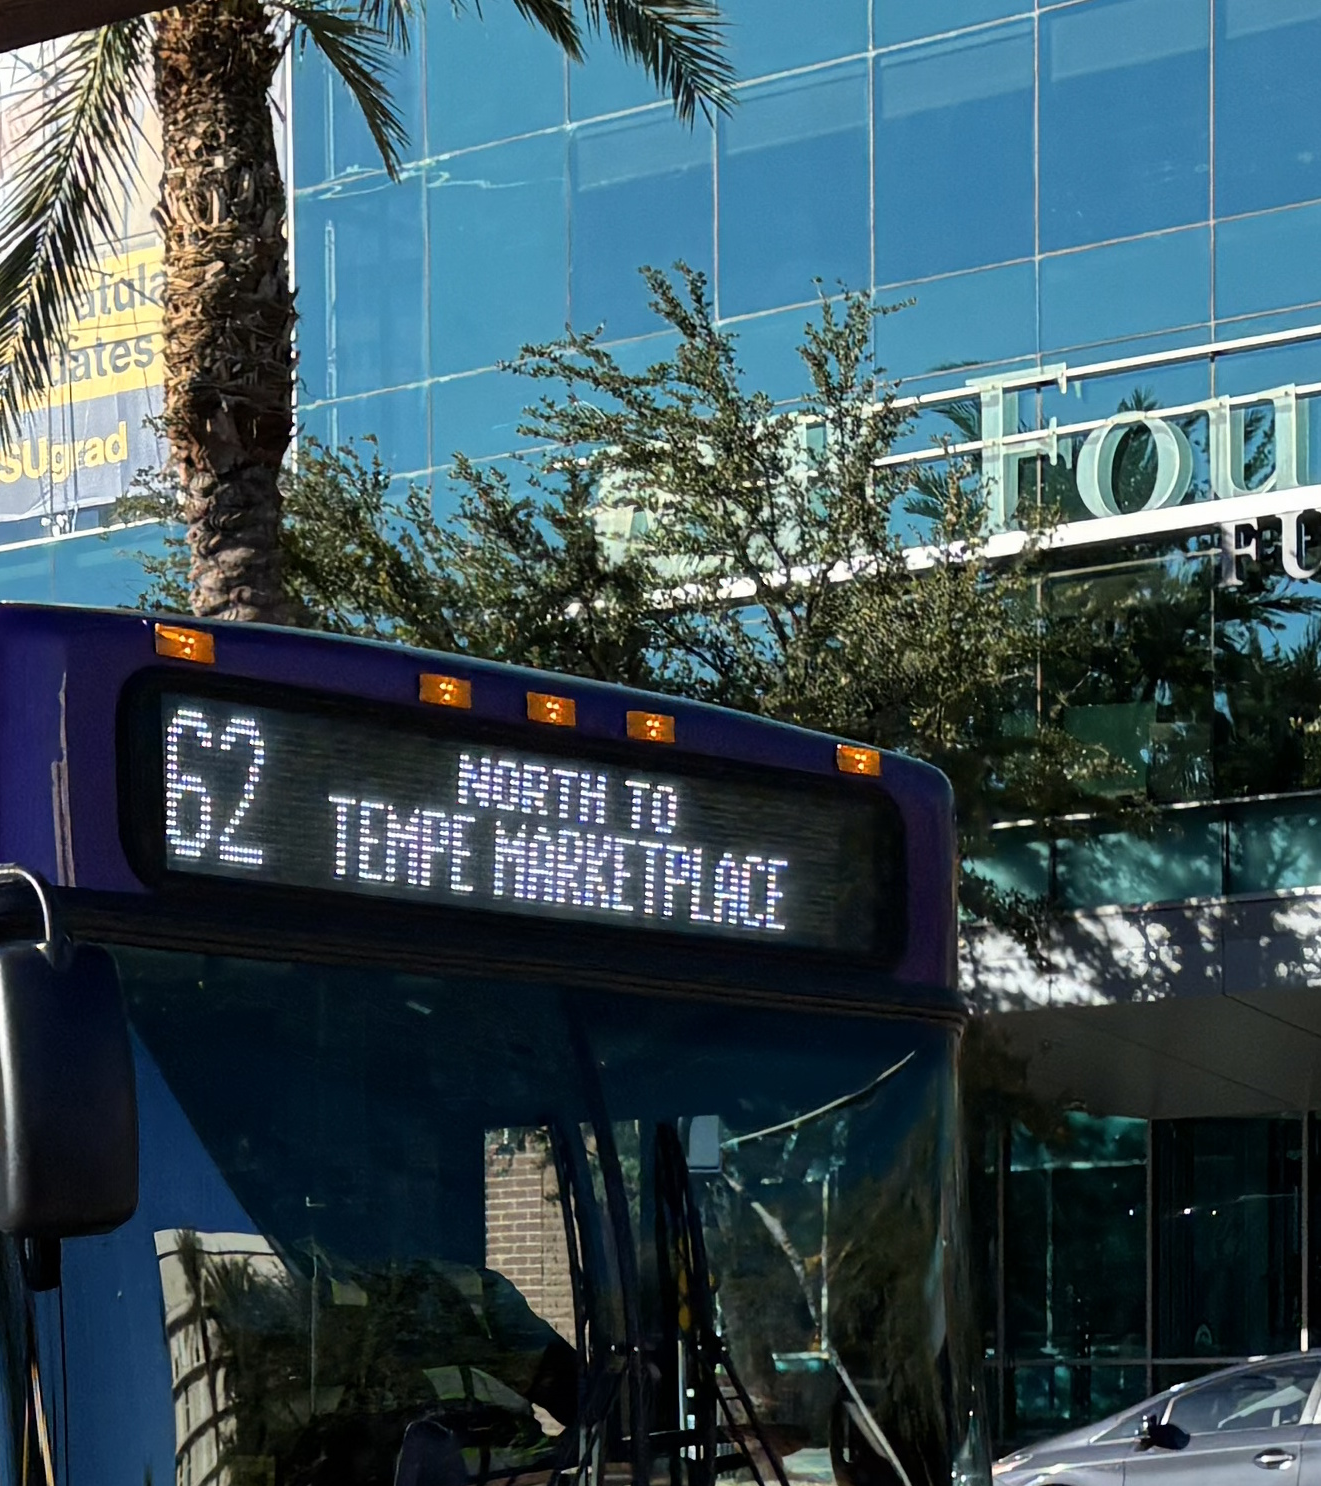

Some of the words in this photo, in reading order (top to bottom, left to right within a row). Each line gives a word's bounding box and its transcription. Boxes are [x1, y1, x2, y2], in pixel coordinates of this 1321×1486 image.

[165, 709, 264, 865] 62
[457, 753, 607, 826] NORTH
[624, 780, 678, 833] TO
[328, 796, 476, 893] TEMPE
[493, 820, 789, 931] MARKETPLACE
